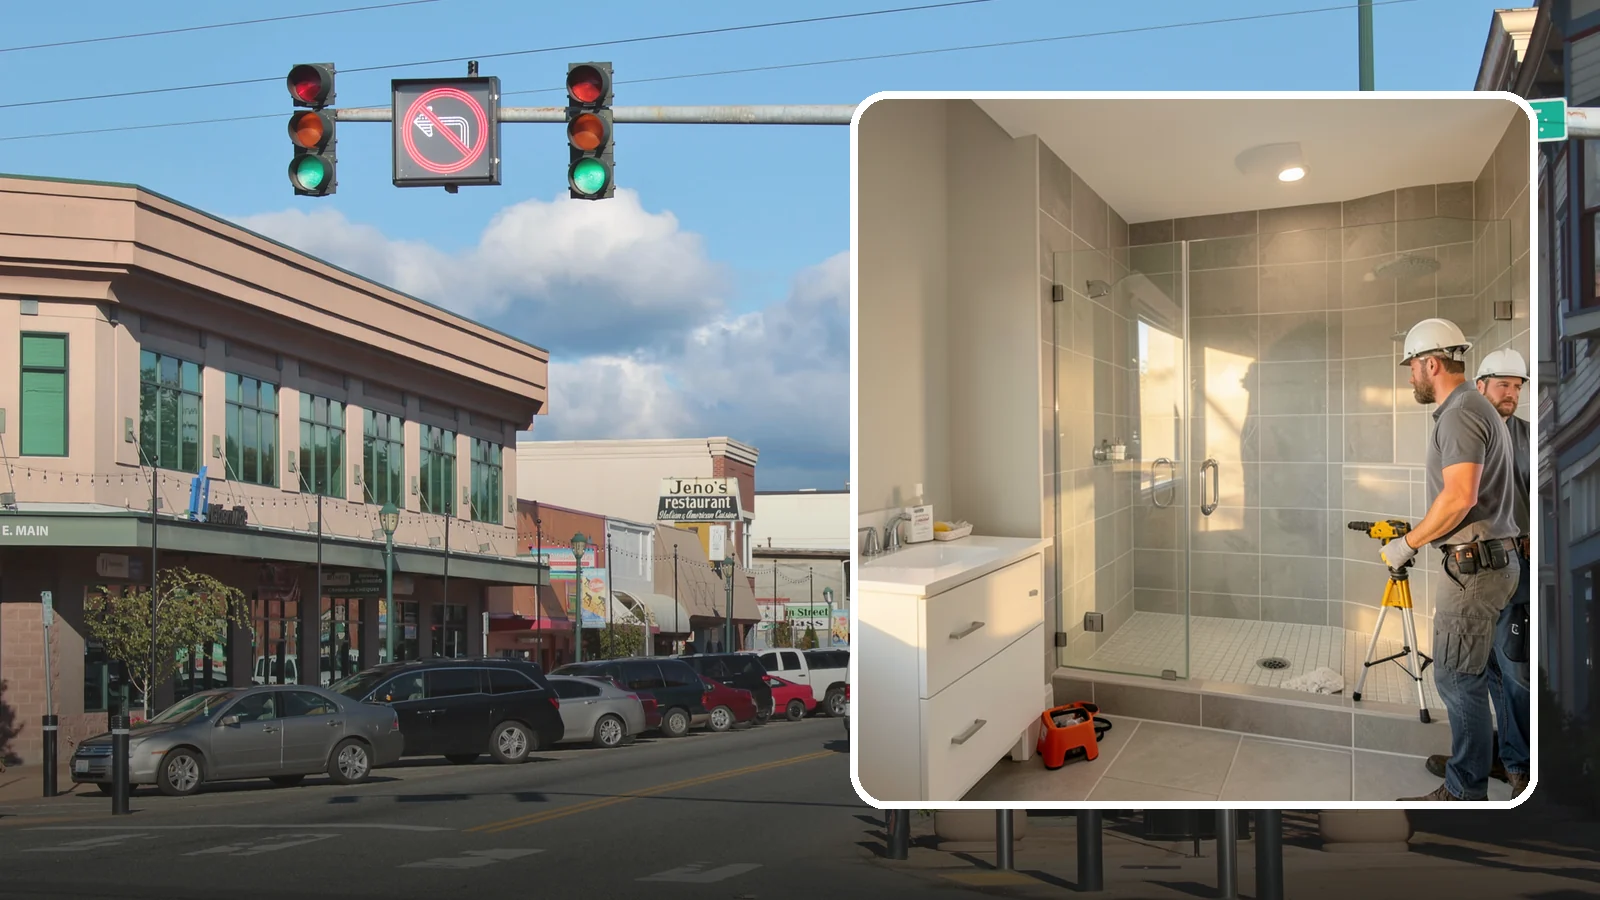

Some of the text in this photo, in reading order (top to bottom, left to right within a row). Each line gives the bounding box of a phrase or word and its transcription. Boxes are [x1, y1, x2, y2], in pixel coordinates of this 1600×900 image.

[669, 480, 728, 494] Jeno's
[665, 496, 731, 509] restaurant
[658, 510, 682, 519] Italian
[686, 509, 714, 519] American
[715, 509, 737, 519] Cuisine
[2, 525, 49, 536] E. MAIN
[797, 607, 829, 617] Street
[791, 619, 824, 627] lass
